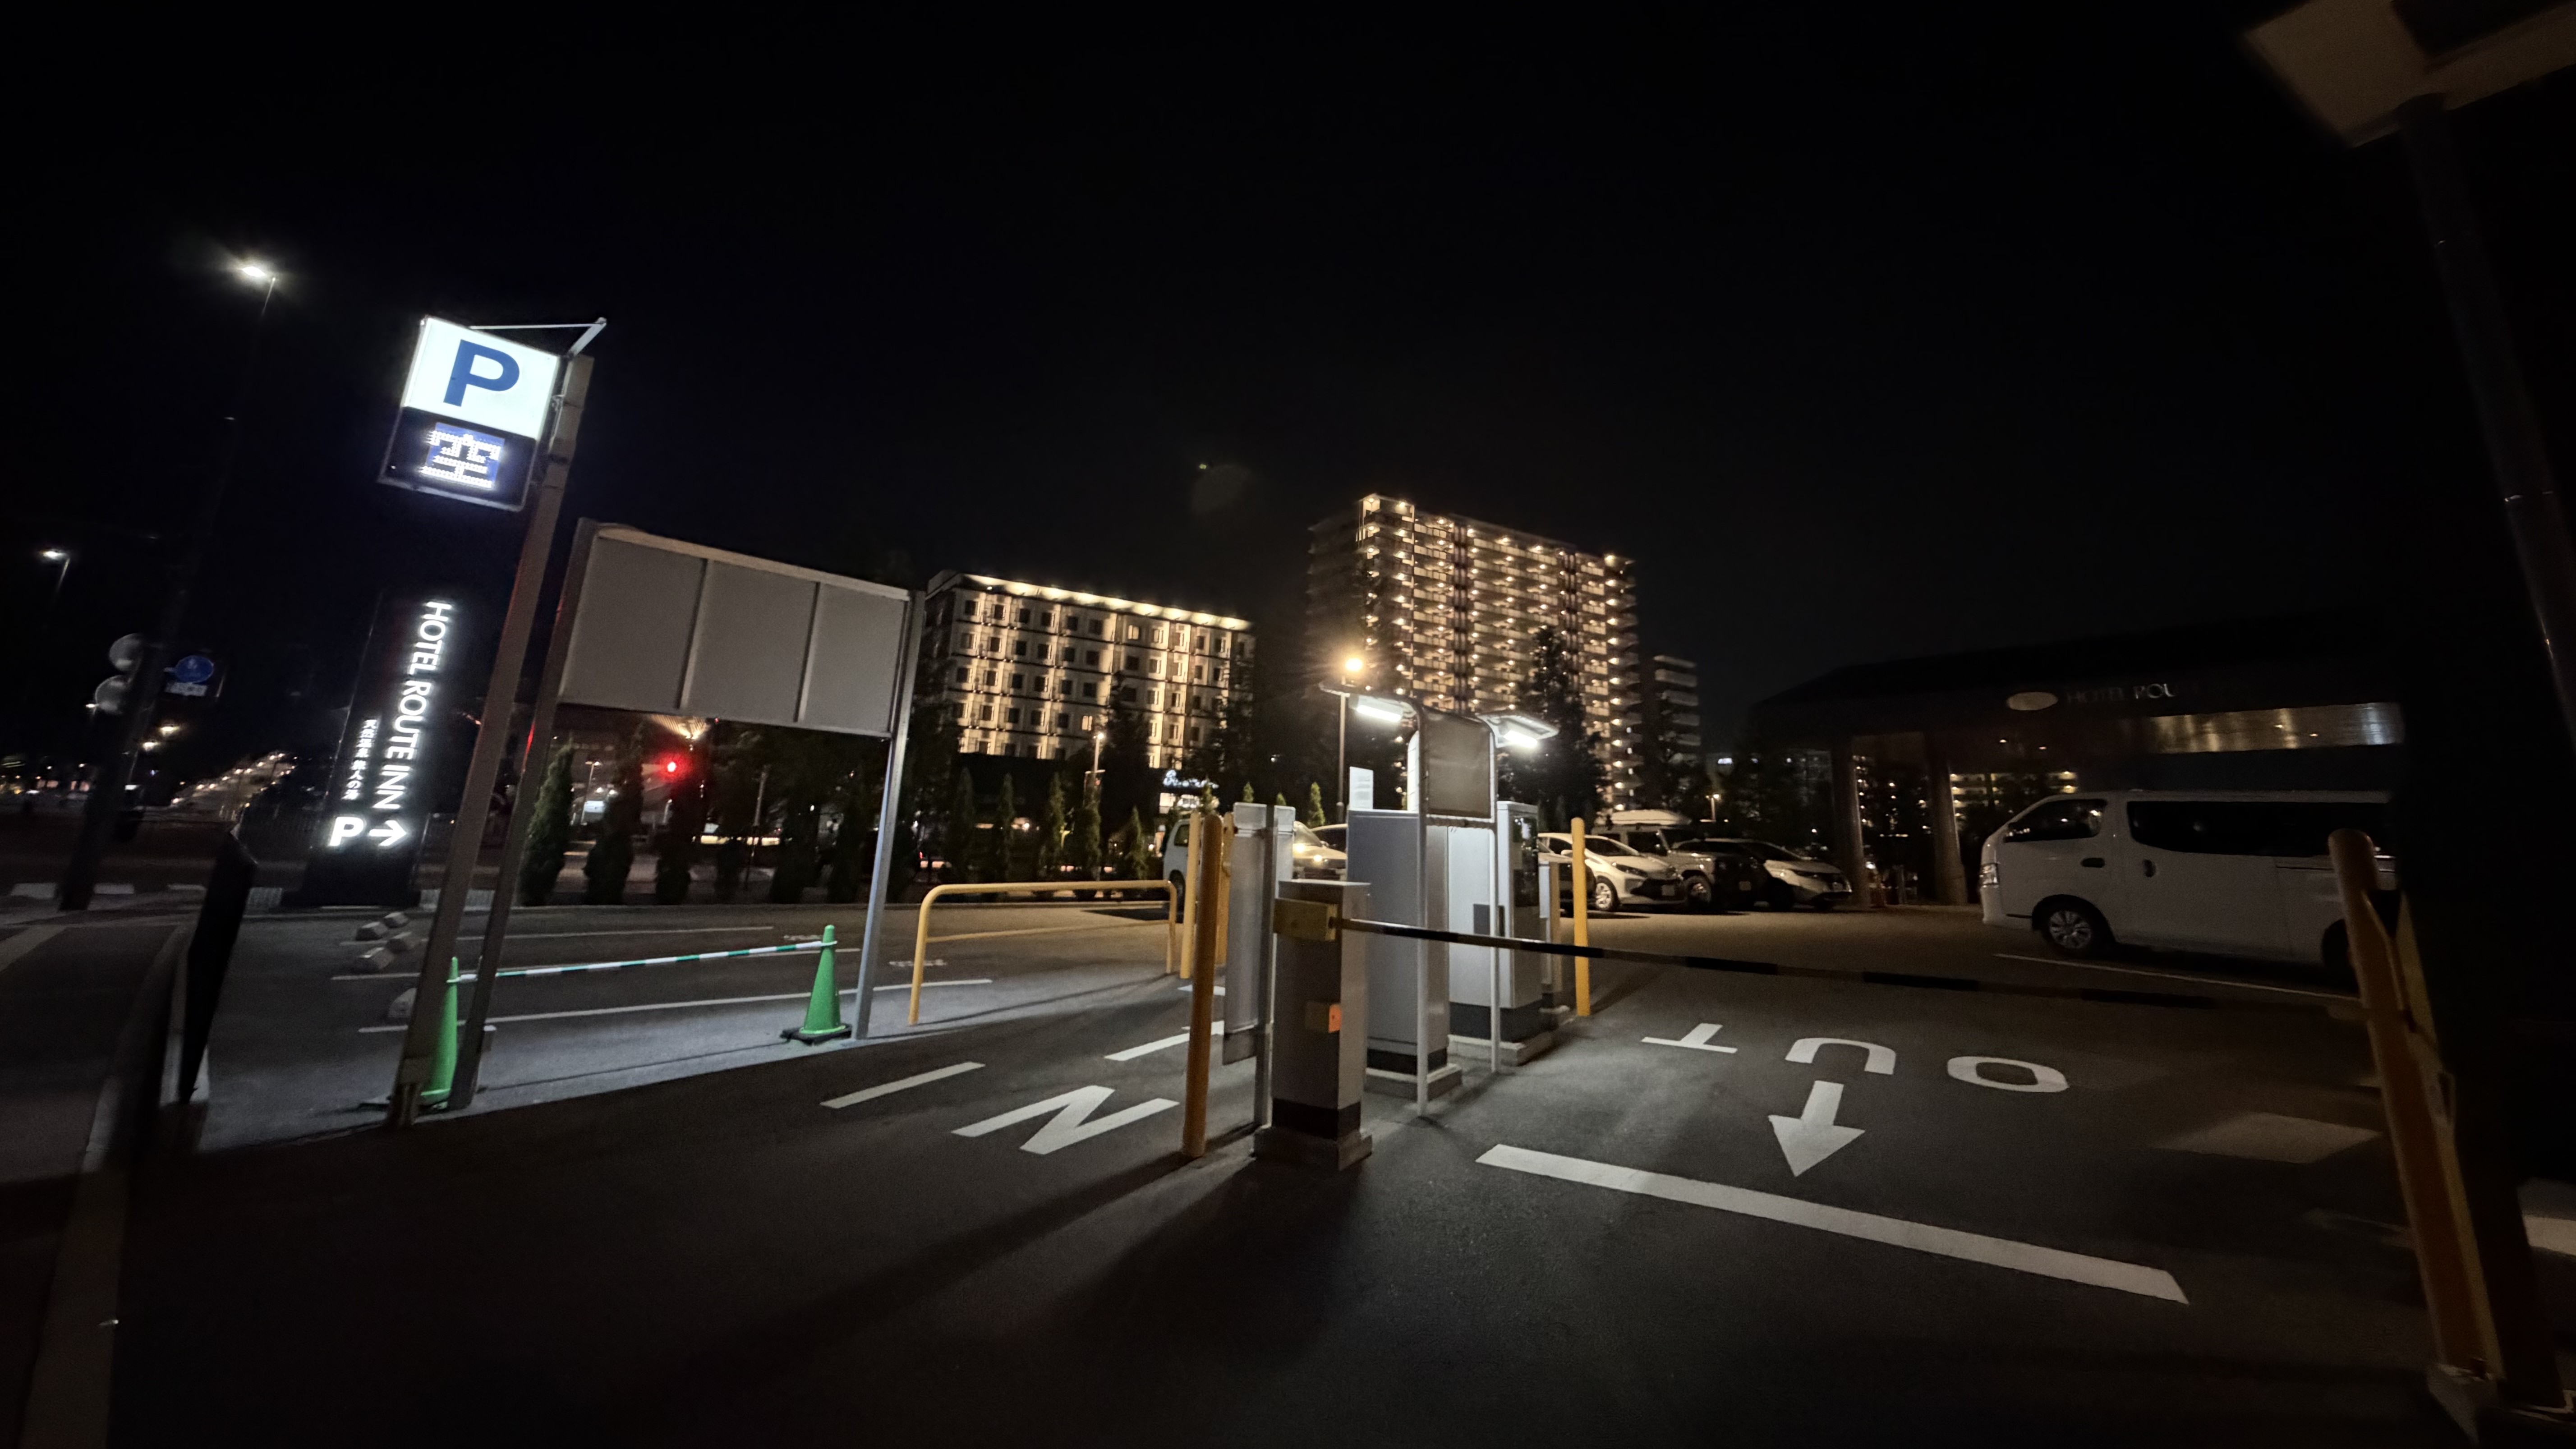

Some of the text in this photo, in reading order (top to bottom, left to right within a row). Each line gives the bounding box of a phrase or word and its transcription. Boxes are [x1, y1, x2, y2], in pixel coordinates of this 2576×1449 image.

[443, 339, 520, 407] P
[419, 433, 501, 488] 空
[373, 601, 451, 810] HOTEL ROUTE INN
[328, 816, 364, 846] P
[1642, 1022, 2070, 1094] OUT
[820, 1061, 1179, 1155] IN
